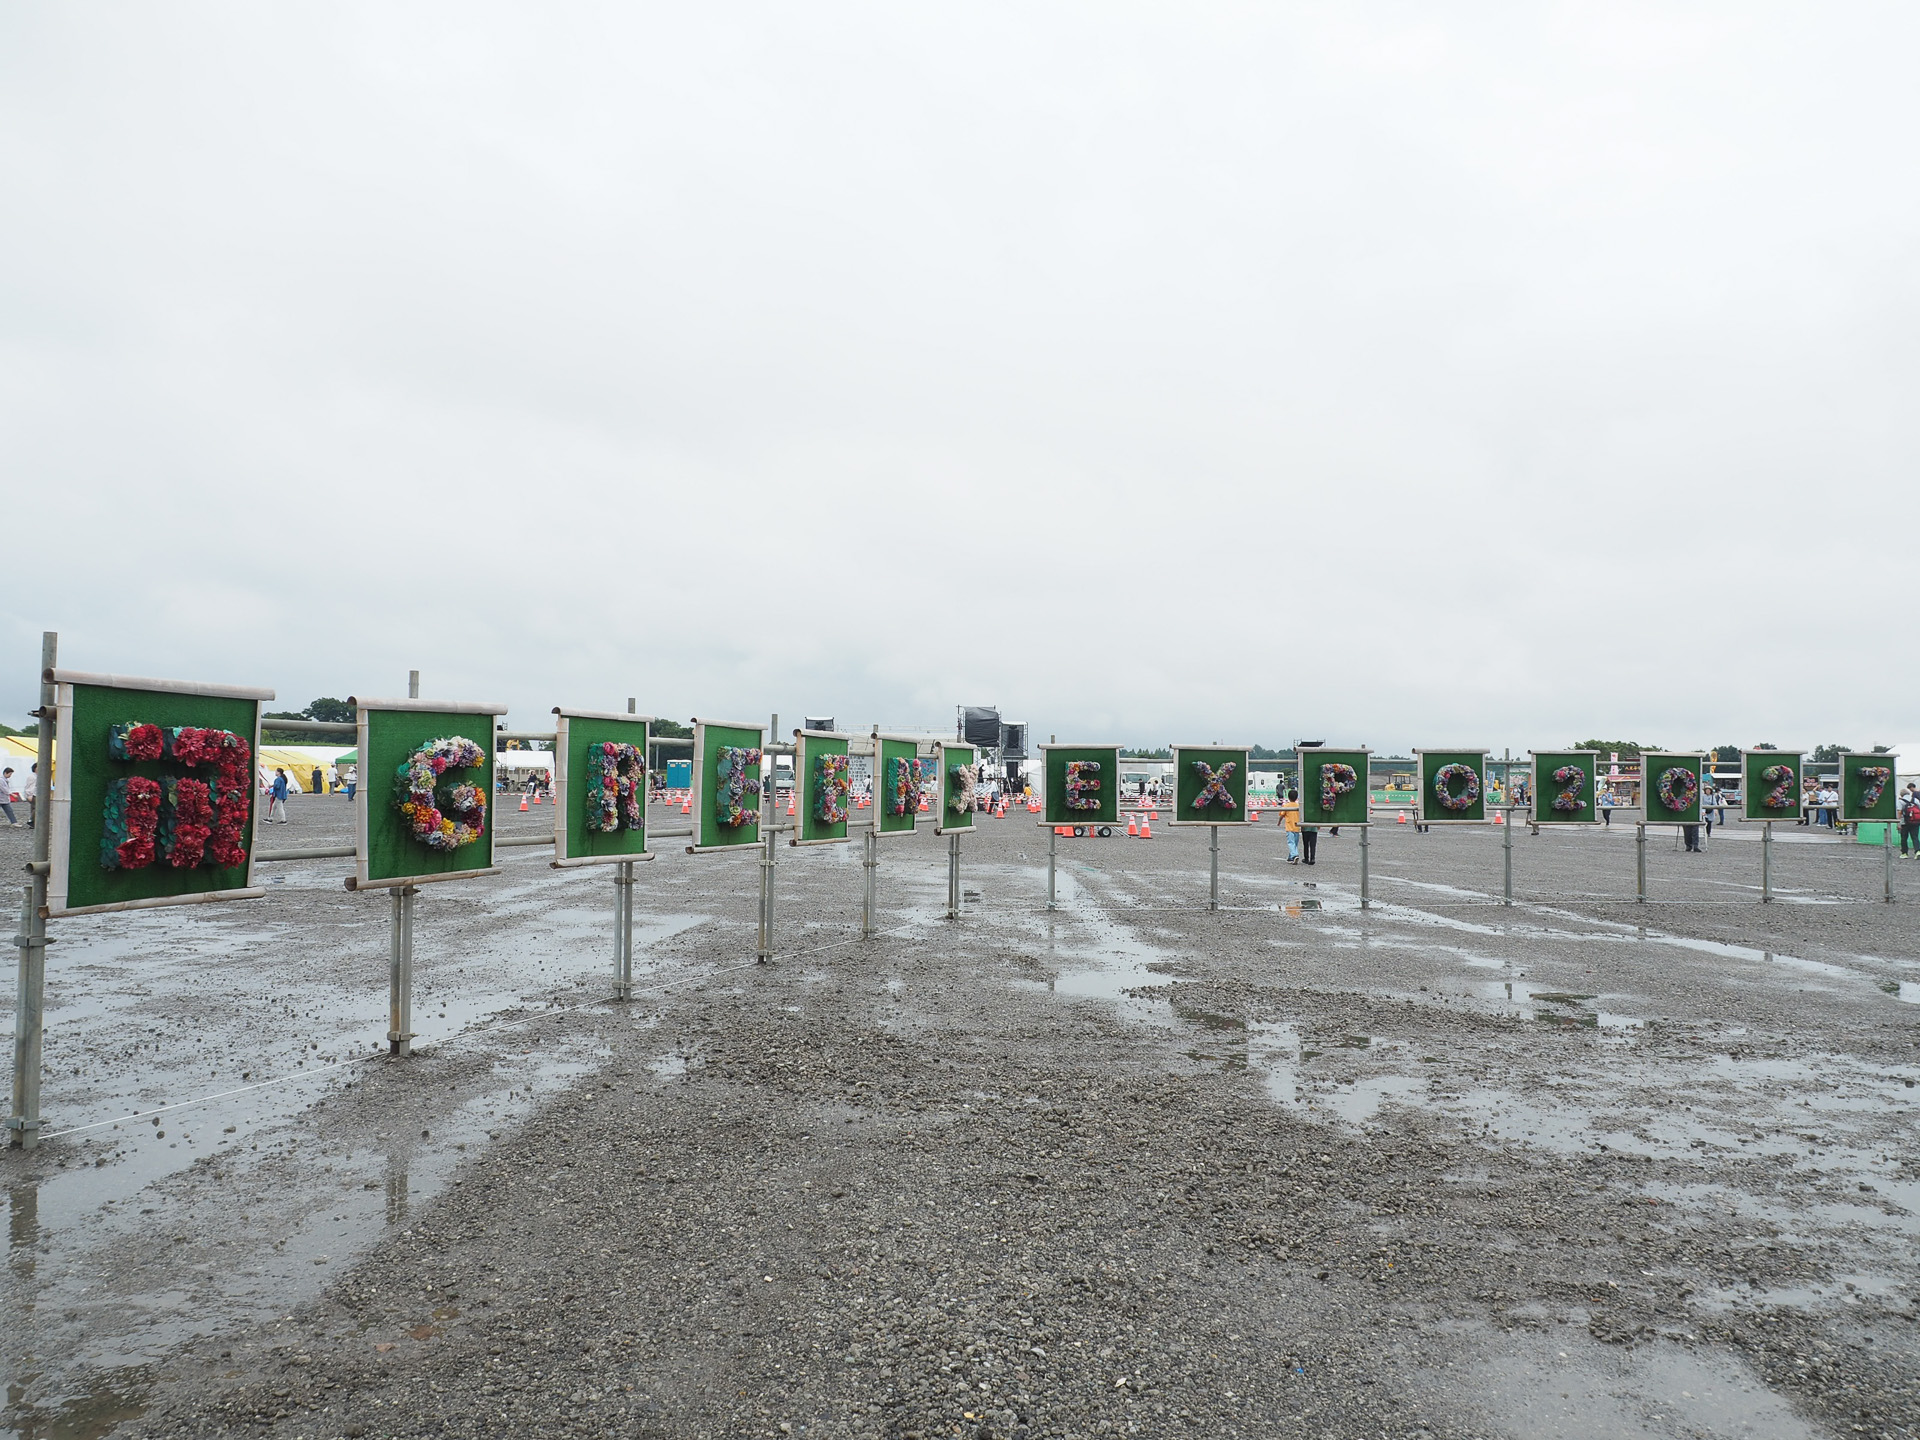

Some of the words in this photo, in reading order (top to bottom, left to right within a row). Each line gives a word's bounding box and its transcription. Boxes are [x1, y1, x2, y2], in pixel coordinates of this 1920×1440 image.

[1065, 760, 1101, 809] E
[1192, 760, 1237, 808] X
[1321, 763, 1358, 811] P
